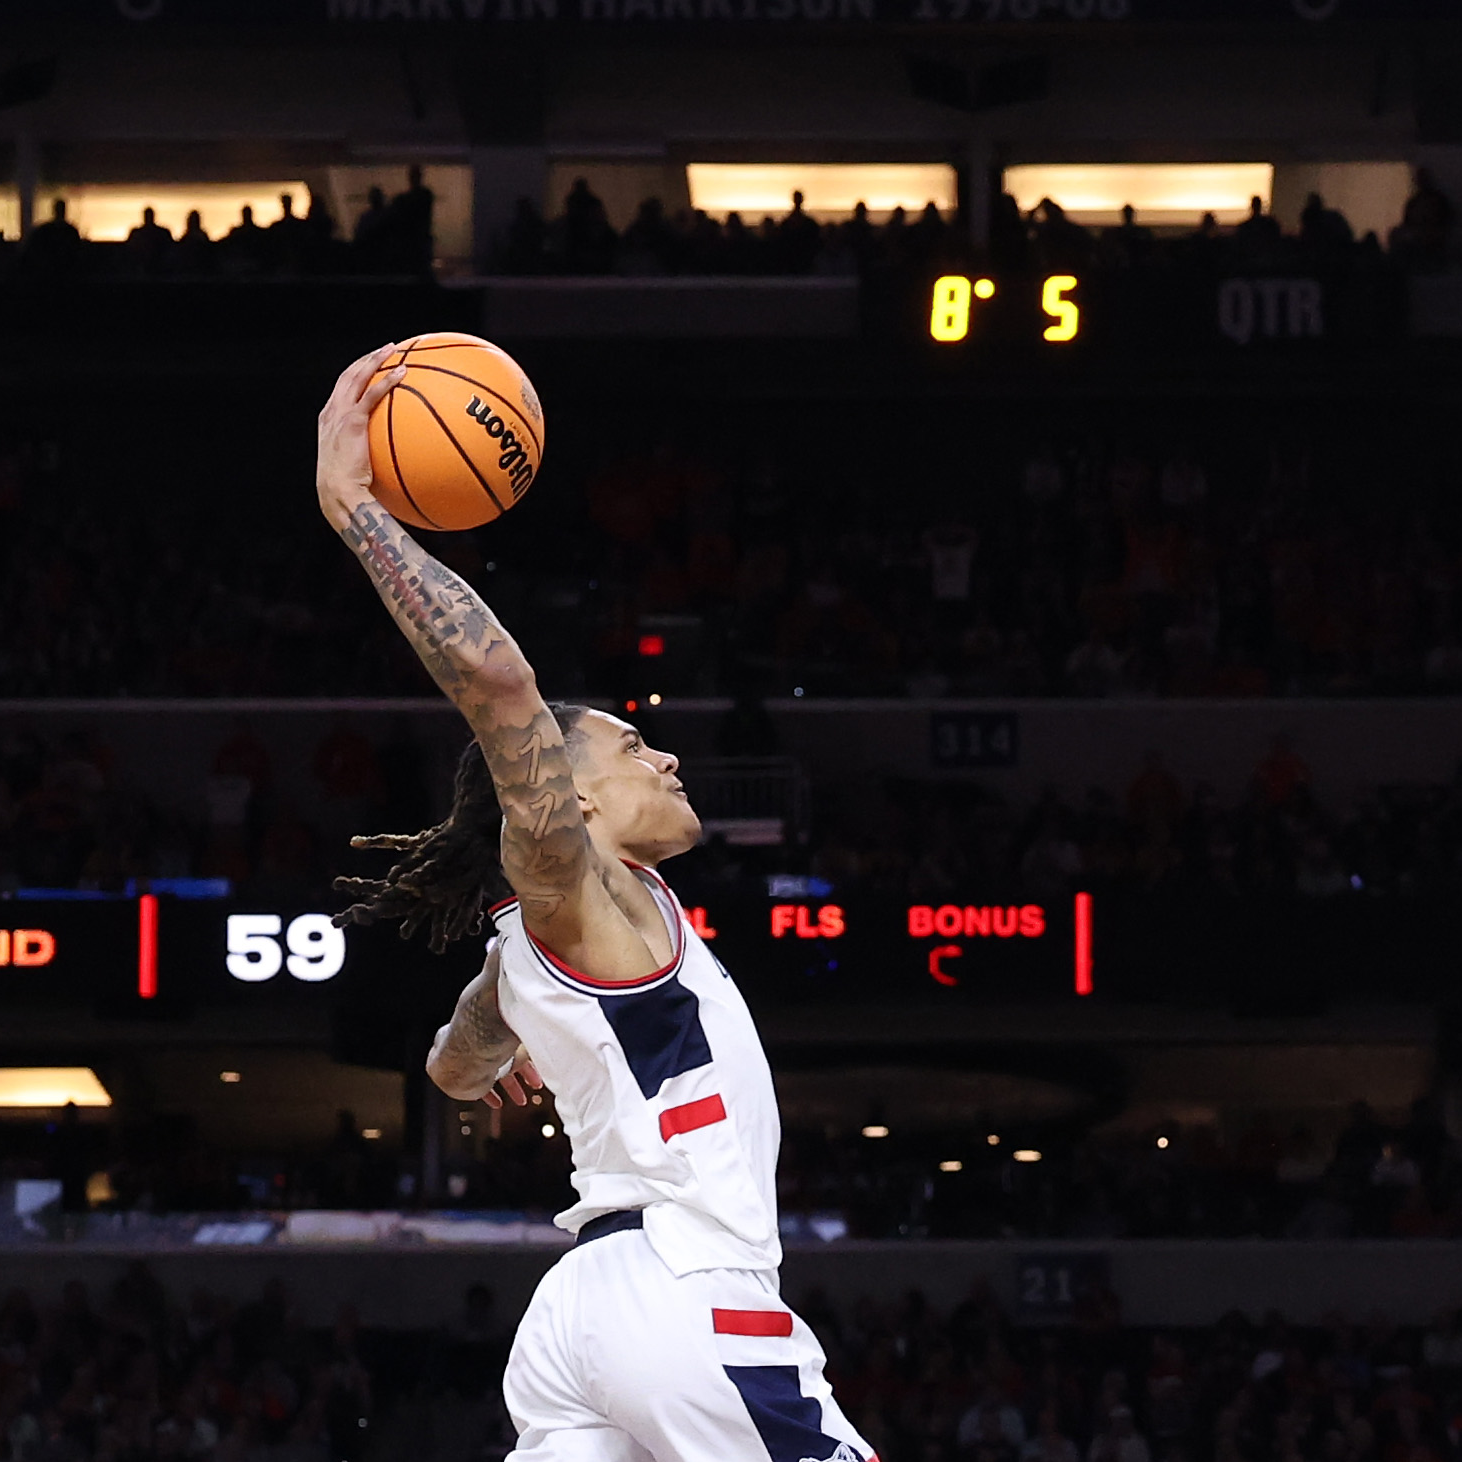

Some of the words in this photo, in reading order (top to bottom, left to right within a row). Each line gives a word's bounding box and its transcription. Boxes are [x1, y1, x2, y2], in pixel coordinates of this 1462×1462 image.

[1219, 278, 1324, 344] QTR
[466, 394, 534, 502] Wilson
[938, 723, 1010, 758] 314
[226, 913, 347, 982] 59
[770, 904, 846, 938] FLS
[907, 904, 1045, 938] BONUS
